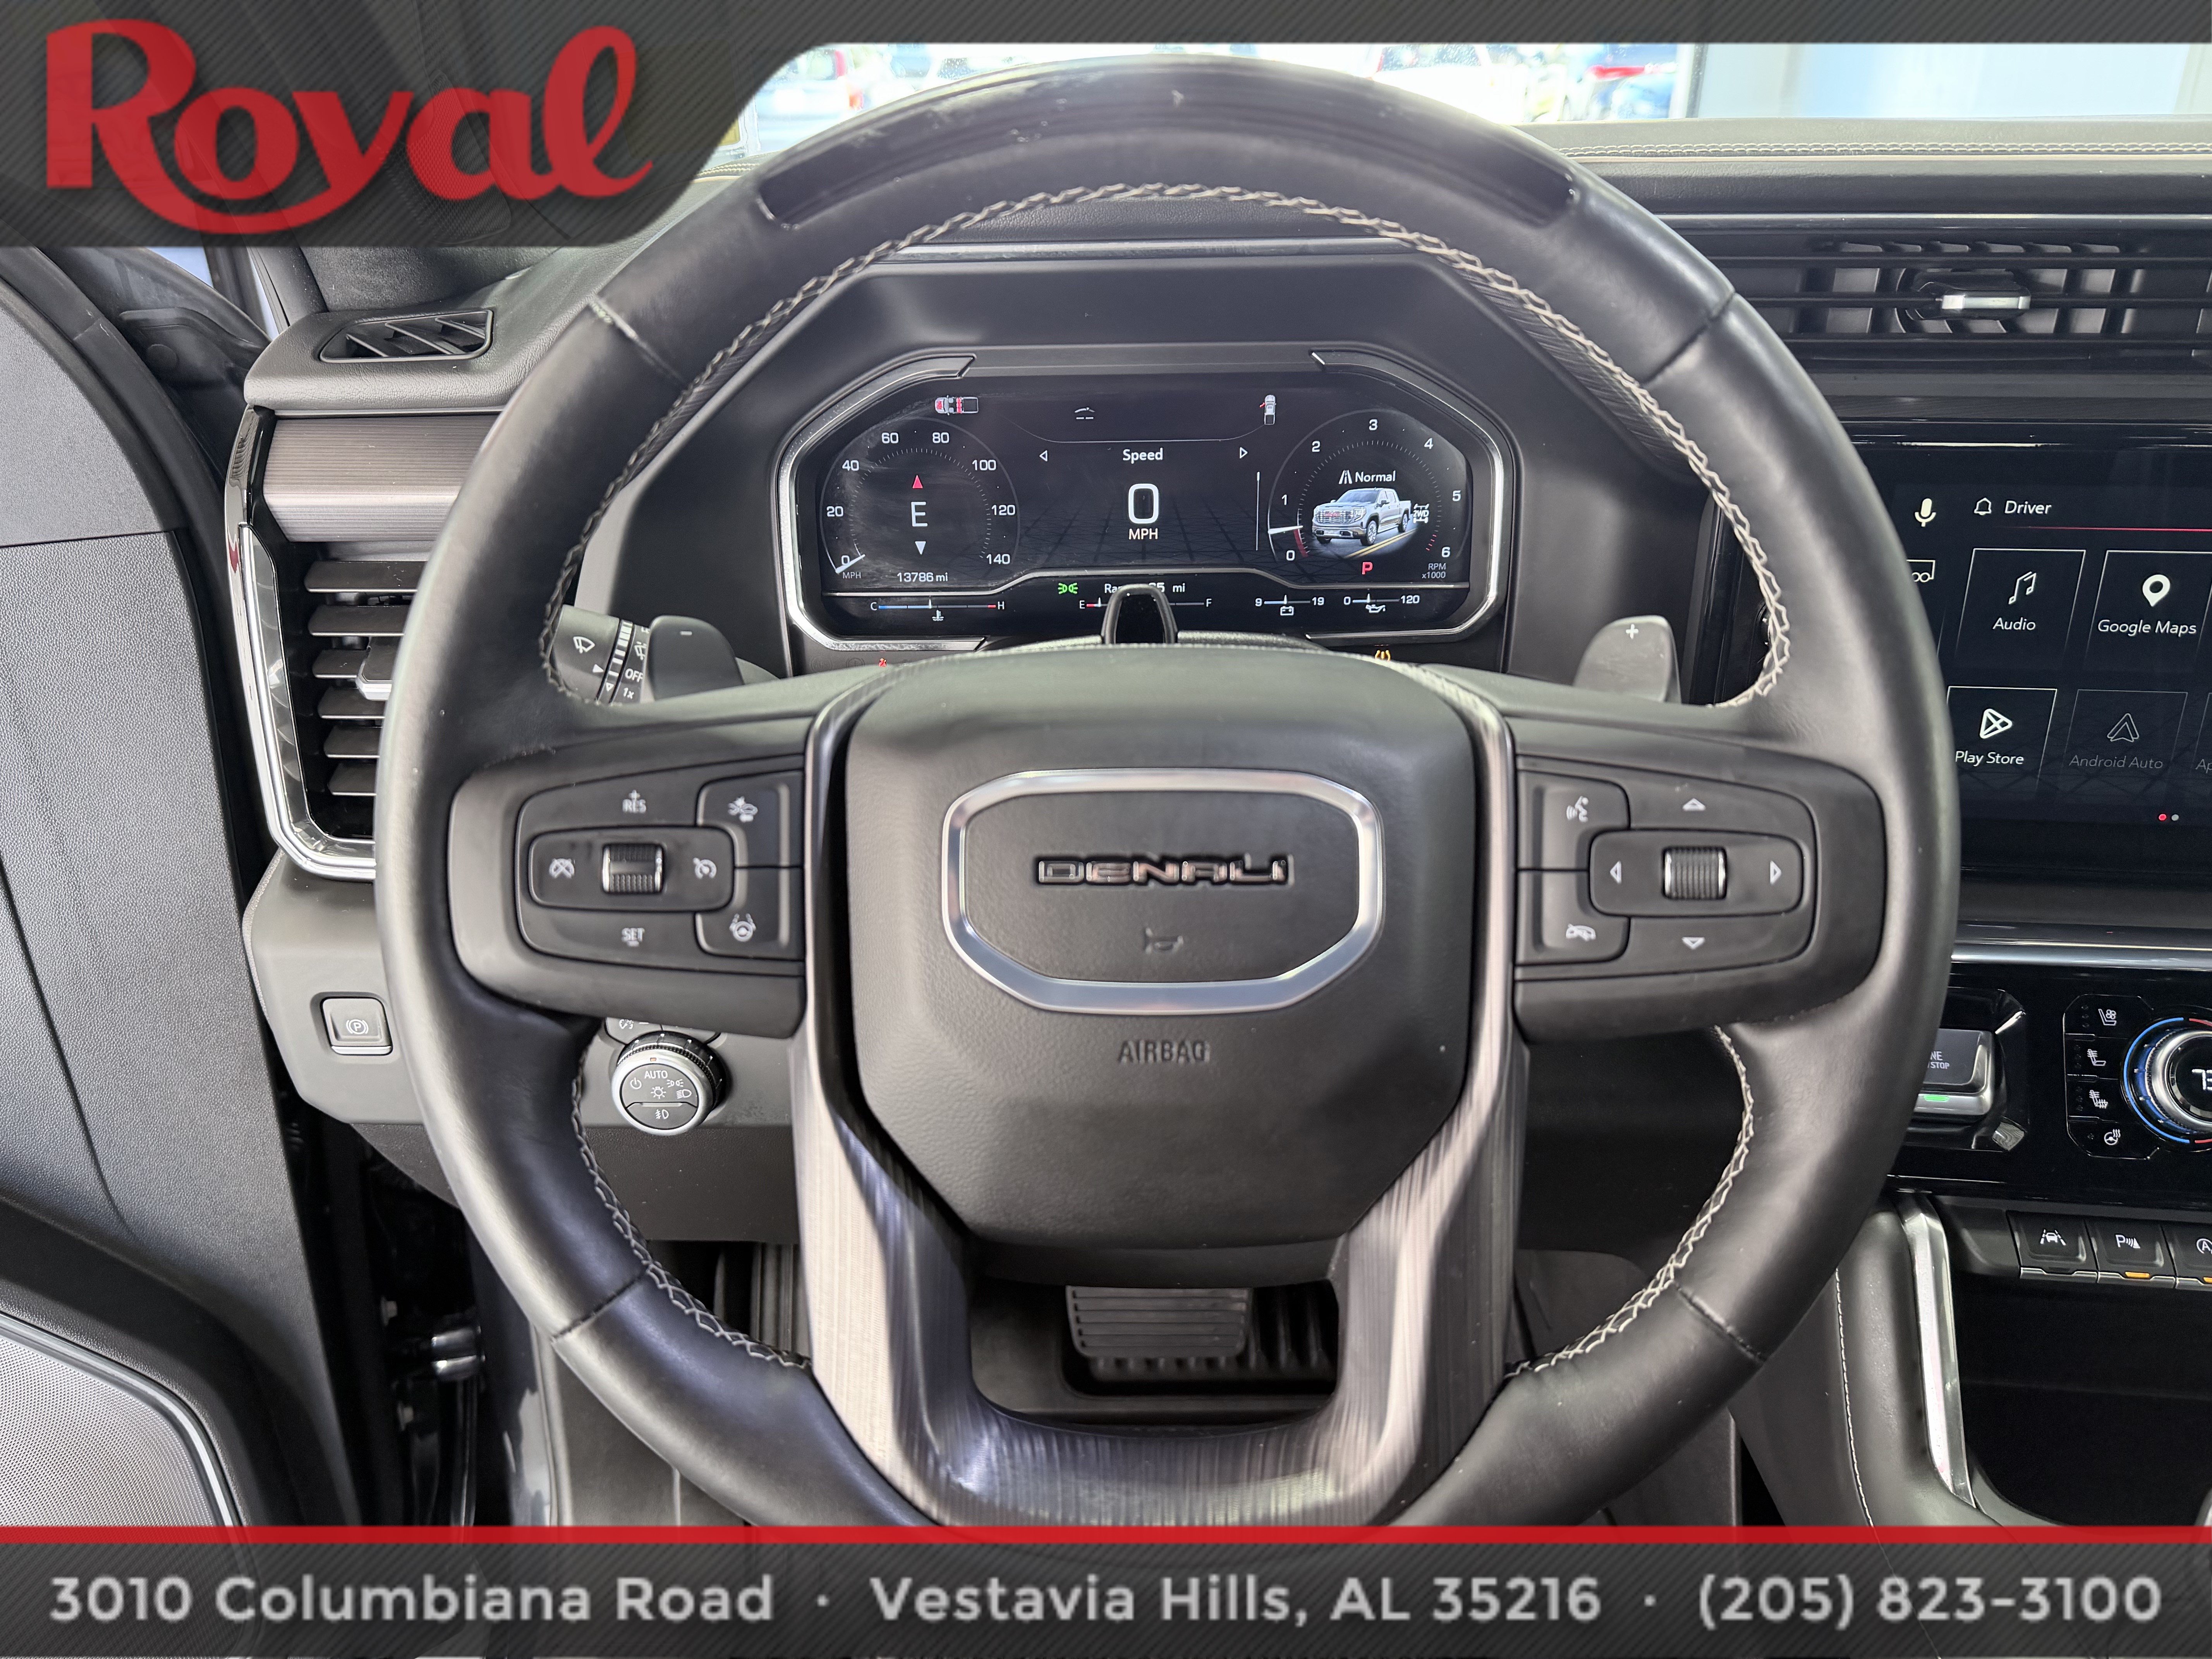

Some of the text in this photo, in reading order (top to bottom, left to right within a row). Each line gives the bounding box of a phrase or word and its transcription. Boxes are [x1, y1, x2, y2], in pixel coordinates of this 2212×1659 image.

[1369, 419, 1378, 431] 3
[881, 432, 899, 444] 60
[932, 432, 950, 443] 80
[1312, 441, 1320, 452] 2
[1424, 438, 1433, 449] 4
[1123, 447, 1163, 464] Speed
[842, 460, 859, 471] 40
[972, 459, 996, 471] 100
[1355, 470, 1396, 483] Normal
[1281, 494, 1287, 505] 1
[1452, 490, 1461, 501] 5
[1128, 483, 1159, 524] 0
[2004, 500, 2052, 514] Driver
[826, 506, 844, 517] 20
[911, 501, 928, 527] E
[991, 505, 1015, 515] 120
[1412, 508, 1430, 518] 2WD
[1128, 528, 1158, 540] MPH
[1286, 550, 1295, 561] 0
[1441, 546, 1450, 558] 6
[841, 555, 850, 566] 0
[986, 554, 1010, 565] 140
[1362, 562, 1373, 575] P
[897, 572, 948, 582] 13786 mi
[1173, 583, 1185, 592] mi
[1079, 600, 1085, 609] E
[1206, 598, 1212, 607] F
[1255, 598, 1262, 606] 9
[1312, 597, 1324, 606] 19
[1343, 596, 1351, 605] 0
[1401, 595, 1420, 604] 120
[870, 602, 877, 611] C
[998, 601, 1005, 610] H
[1992, 617, 2036, 630] Audio
[2098, 619, 2197, 637] Google Maps
[625, 668, 644, 682] OFF
[623, 687, 634, 699] 1x
[1955, 750, 2024, 767] Play Store
[2068, 754, 2164, 770] Android Auto
[622, 799, 647, 813] RES
[1036, 854, 1290, 884] DENALI
[621, 927, 646, 942] SET
[1120, 1041, 1209, 1062] AIRBAG
[644, 1070, 668, 1080] AUTO
